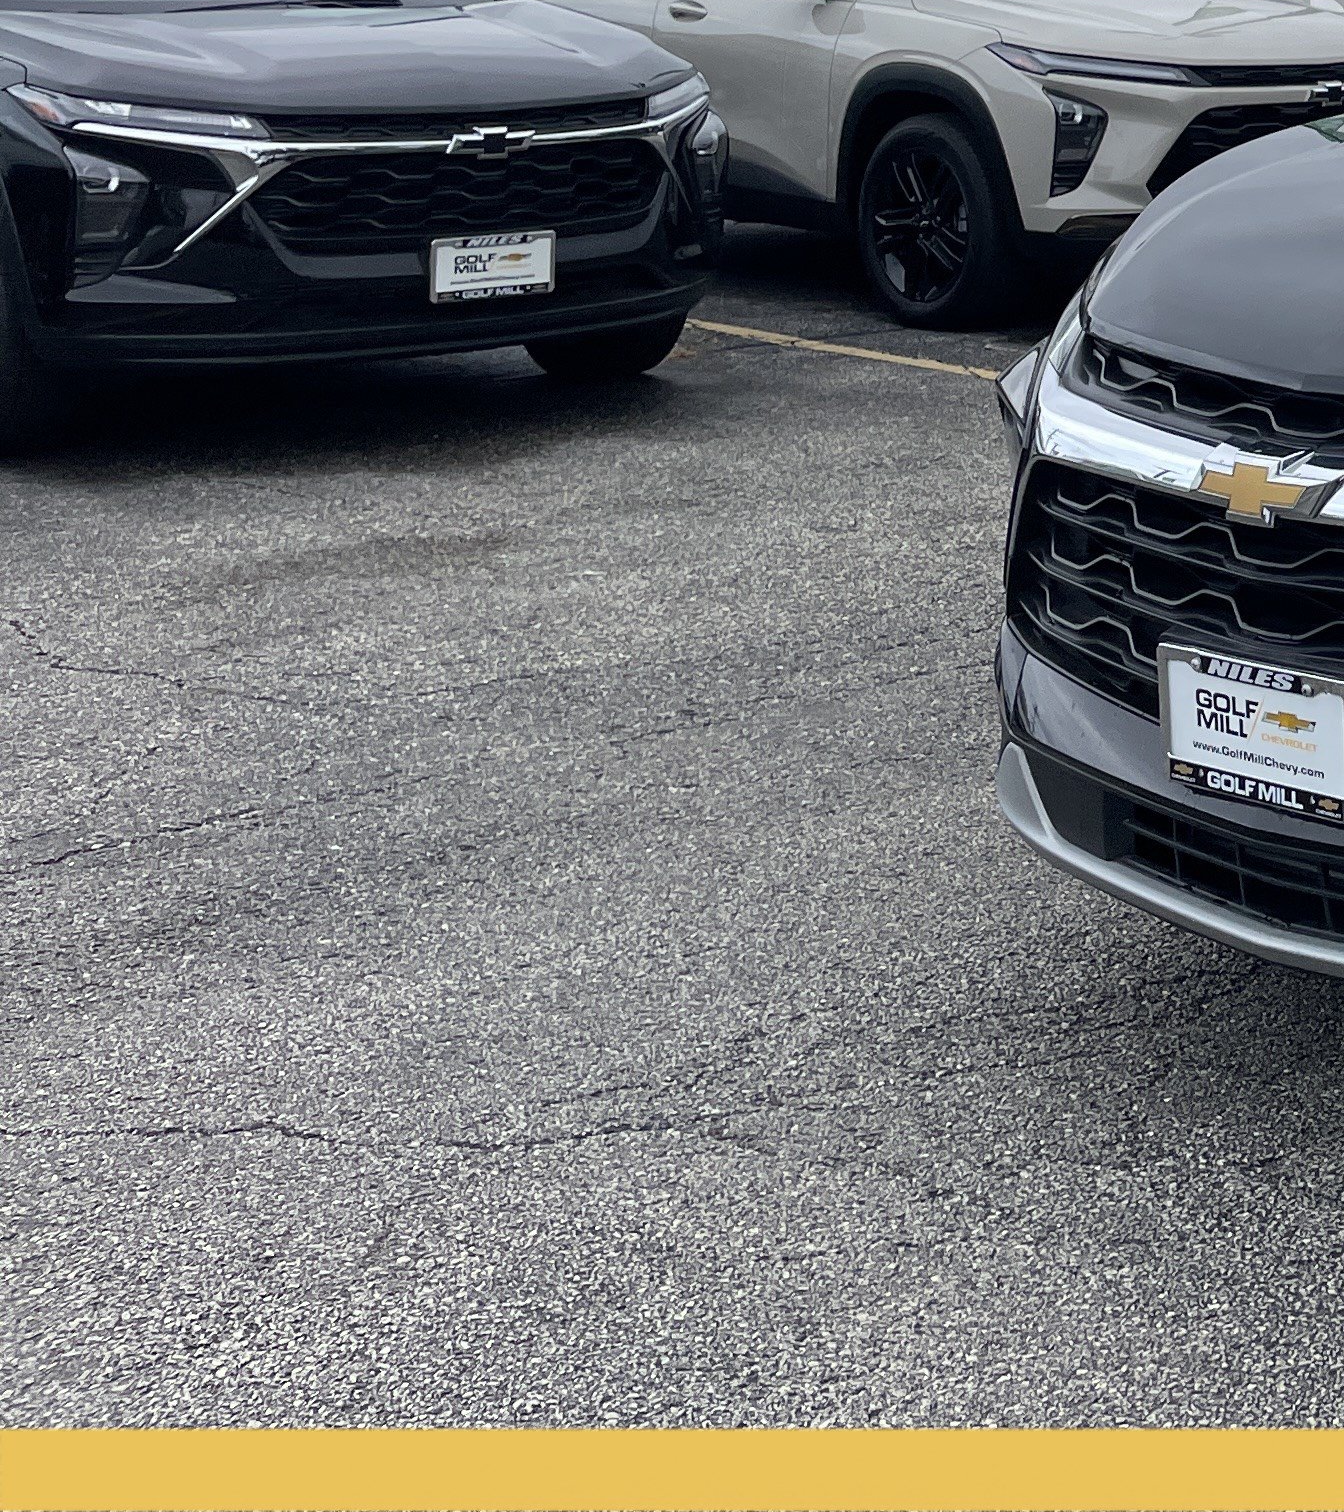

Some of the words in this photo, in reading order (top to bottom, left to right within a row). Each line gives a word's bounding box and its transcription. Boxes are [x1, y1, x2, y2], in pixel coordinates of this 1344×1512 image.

[454, 252, 498, 265] GOLF
[454, 262, 489, 275] MILL
[495, 285, 525, 296] MILL
[1206, 658, 1296, 691] NILES
[1195, 688, 1260, 719] GOLF
[1196, 707, 1249, 738] MILL
[1261, 732, 1317, 752] CHEVROLET
[1192, 739, 1326, 780] www.GolfMillChevy.com
[1206, 769, 1257, 797] GOLF
[1258, 784, 1304, 810] MILL
